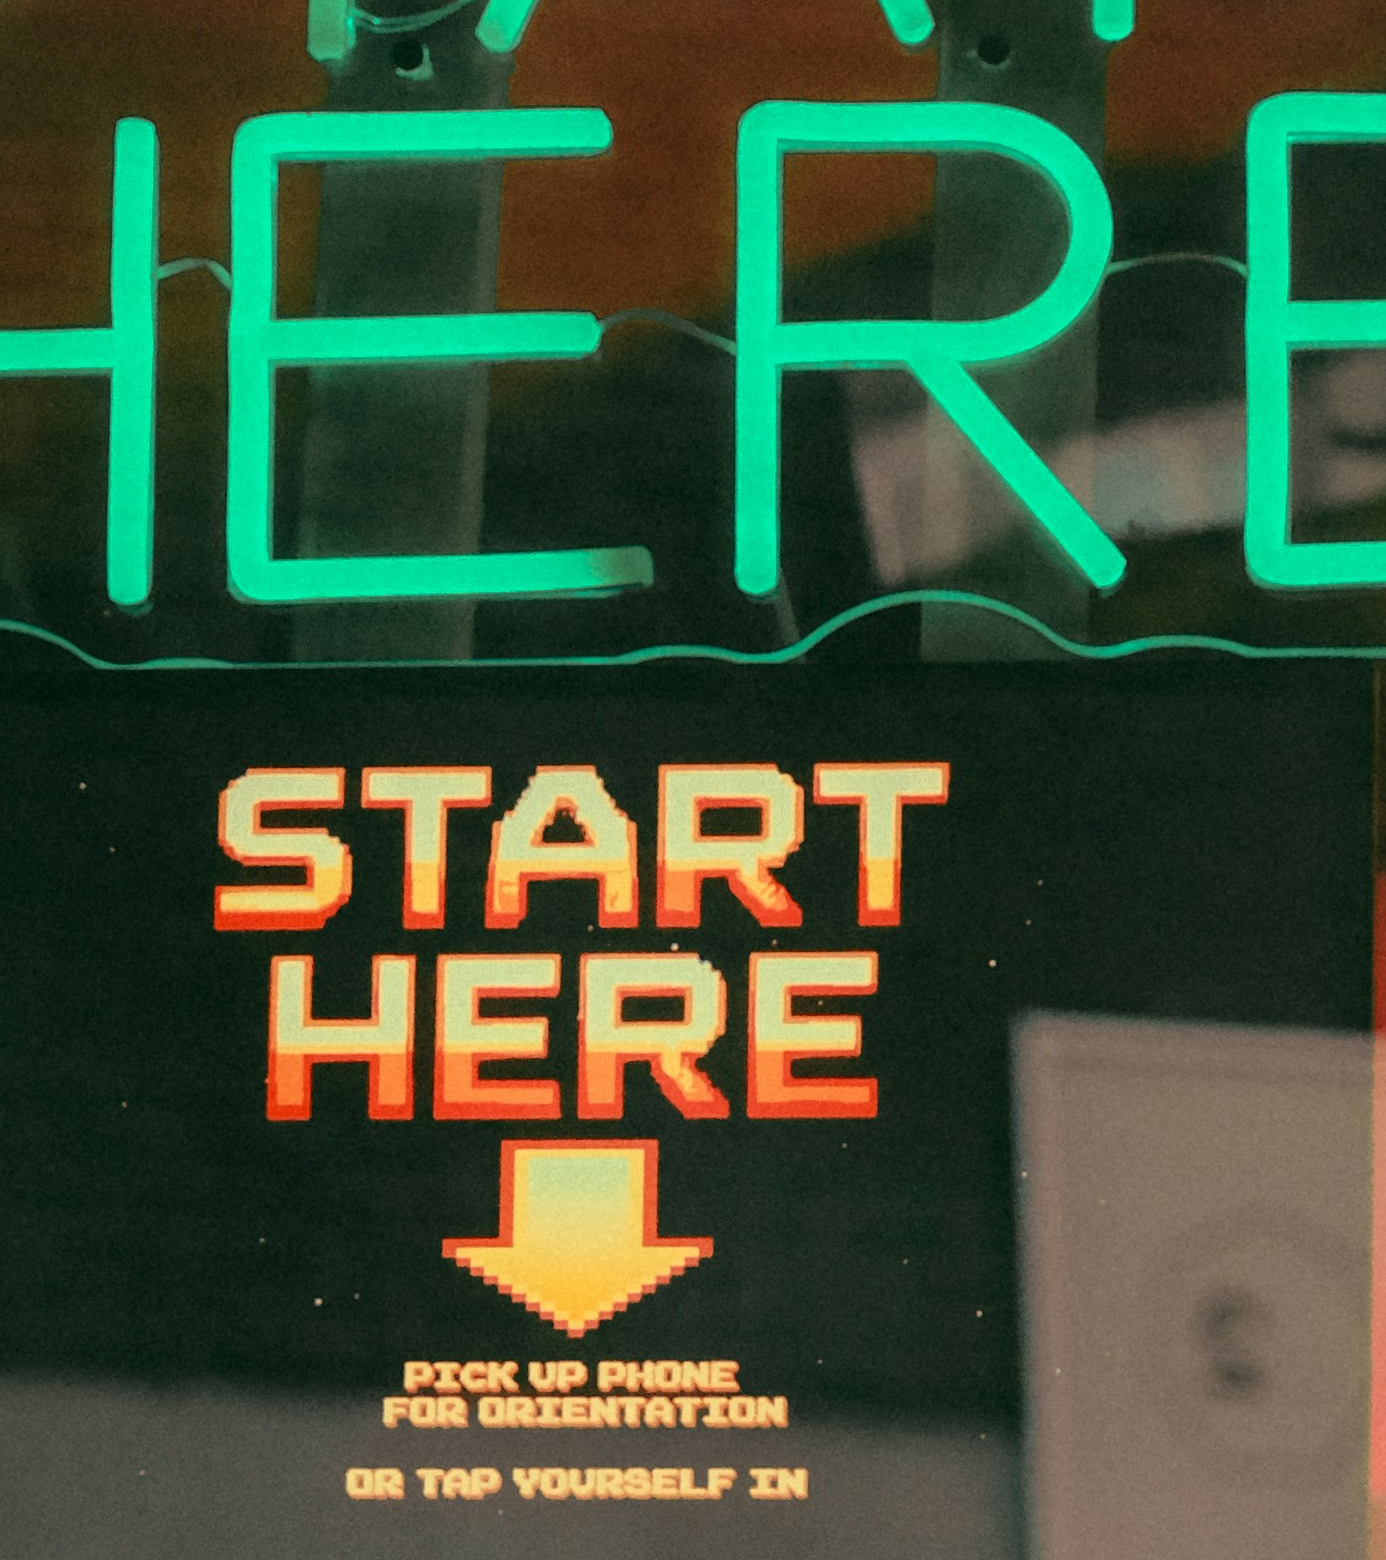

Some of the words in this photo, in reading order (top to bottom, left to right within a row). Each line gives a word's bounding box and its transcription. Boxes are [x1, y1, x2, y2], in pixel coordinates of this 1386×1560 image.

[214, 762, 950, 931] START
[266, 952, 878, 1120] HERE
[404, 1362, 519, 1394] PICK
[529, 1361, 588, 1394] UP
[598, 1361, 739, 1393] PHONE
[384, 1396, 467, 1427] FOR
[479, 1397, 786, 1426] ORIENTATION
[346, 1468, 404, 1499] OR
[417, 1468, 502, 1499] TAP
[513, 1468, 736, 1499] YOURSELF
[750, 1468, 808, 1499] IN
